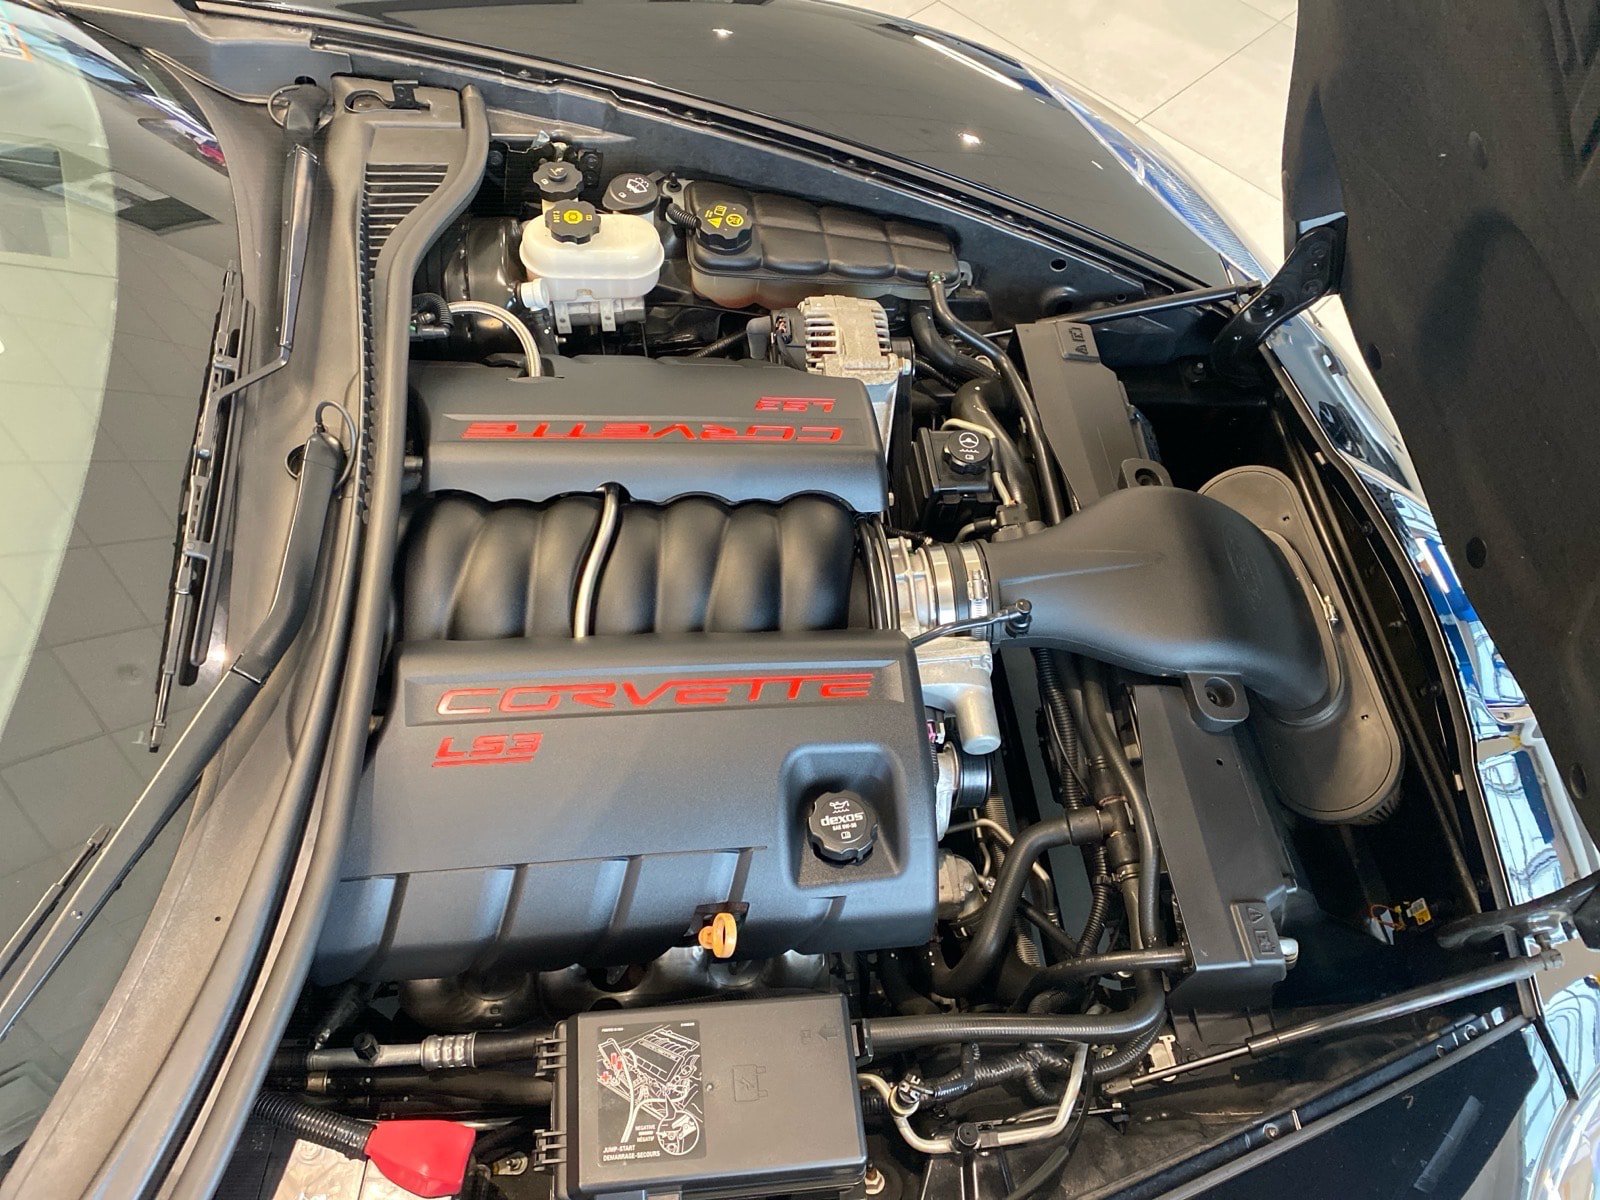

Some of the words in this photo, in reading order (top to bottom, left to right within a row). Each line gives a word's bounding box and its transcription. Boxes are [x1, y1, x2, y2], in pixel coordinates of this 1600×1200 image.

[755, 397, 837, 412] LS3
[460, 422, 843, 443] CORVETTE
[436, 673, 875, 716] CORVETTE
[434, 732, 544, 761] LS3
[820, 811, 865, 827] dexos
[603, 1145, 636, 1153] JUMP-START
